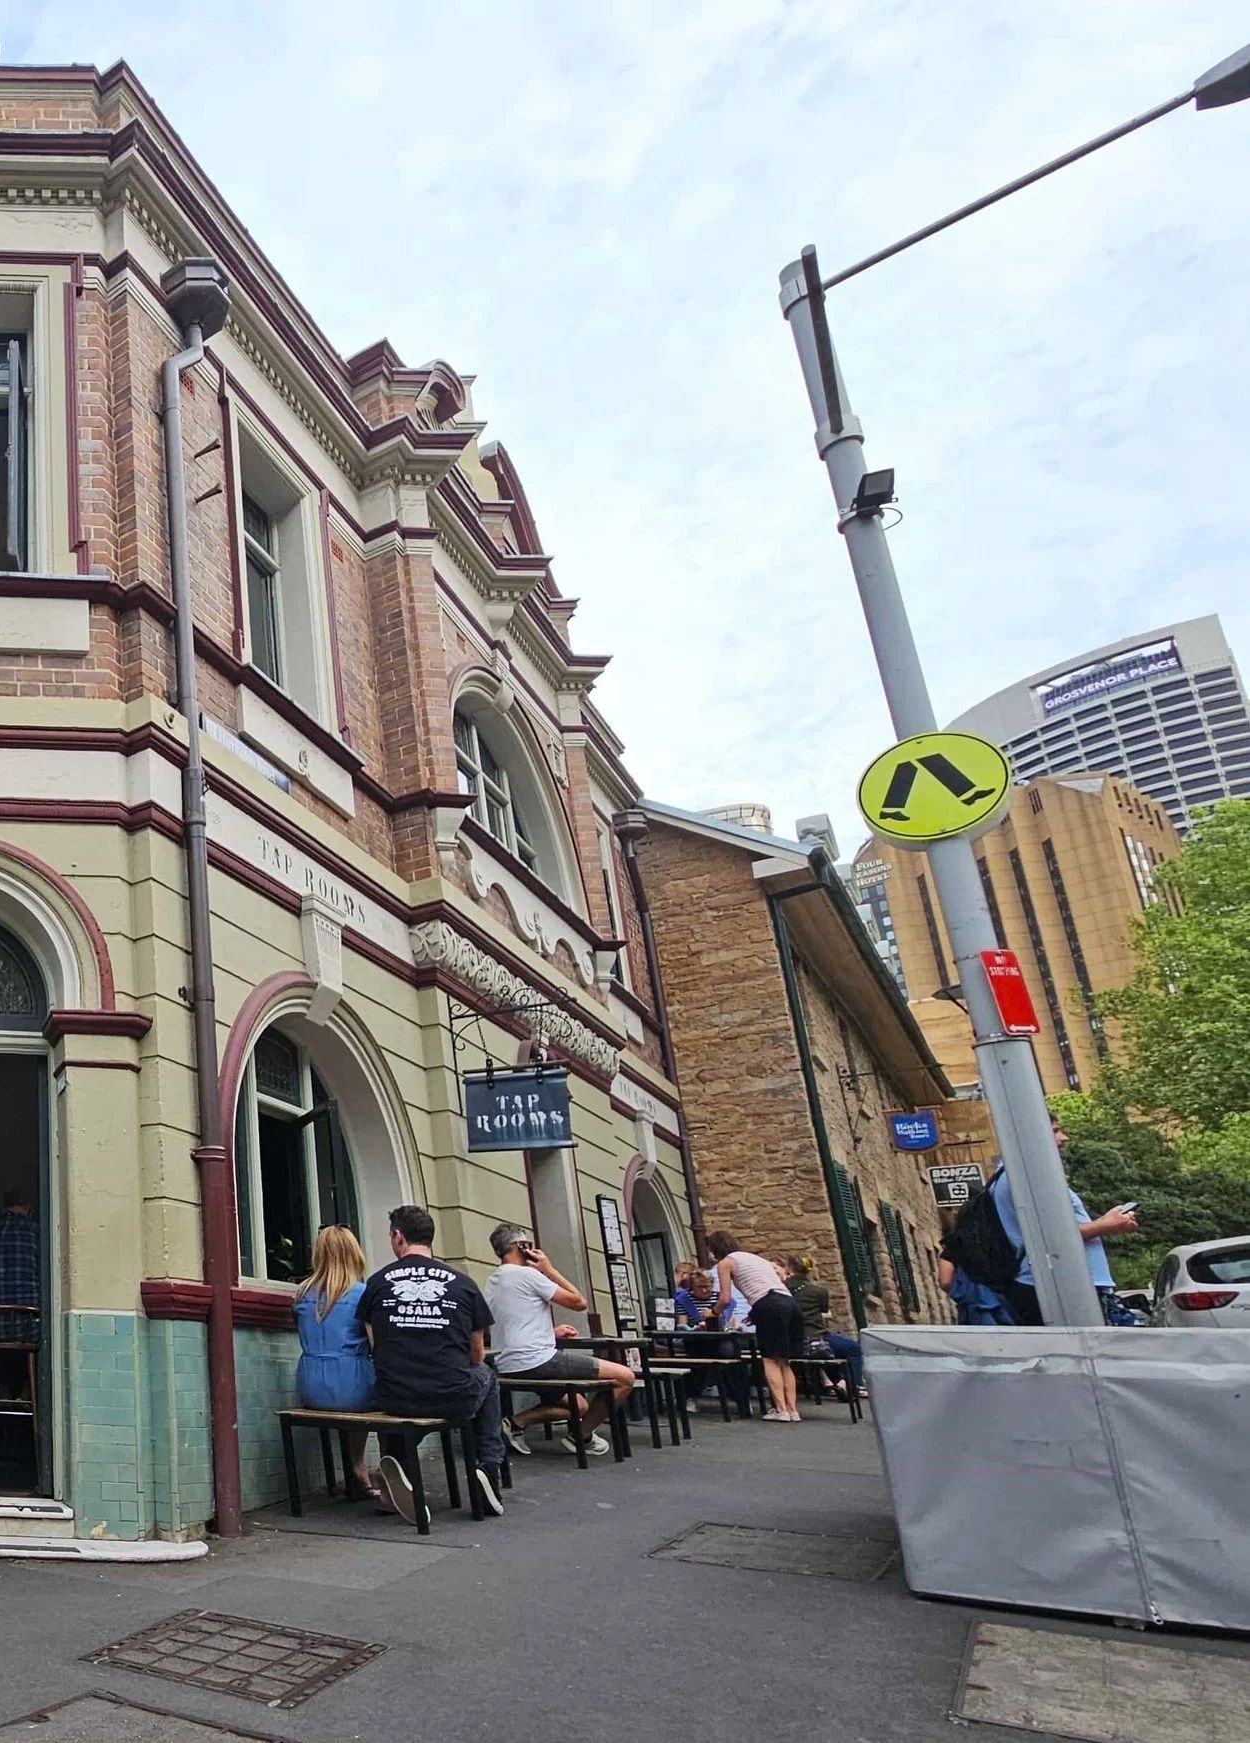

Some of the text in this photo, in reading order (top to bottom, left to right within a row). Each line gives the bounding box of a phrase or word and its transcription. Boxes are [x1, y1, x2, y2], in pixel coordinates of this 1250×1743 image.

[1044, 657, 1179, 709] GROSVENOR PLACE
[258, 836, 366, 924] TAP ROOMS
[989, 966, 1020, 976] STOPPING
[496, 1093, 540, 1110] TAP
[477, 1110, 564, 1132] ROOMS
[932, 1166, 978, 1178] BONZA
[384, 1266, 456, 1281] SIMPLE CITY
